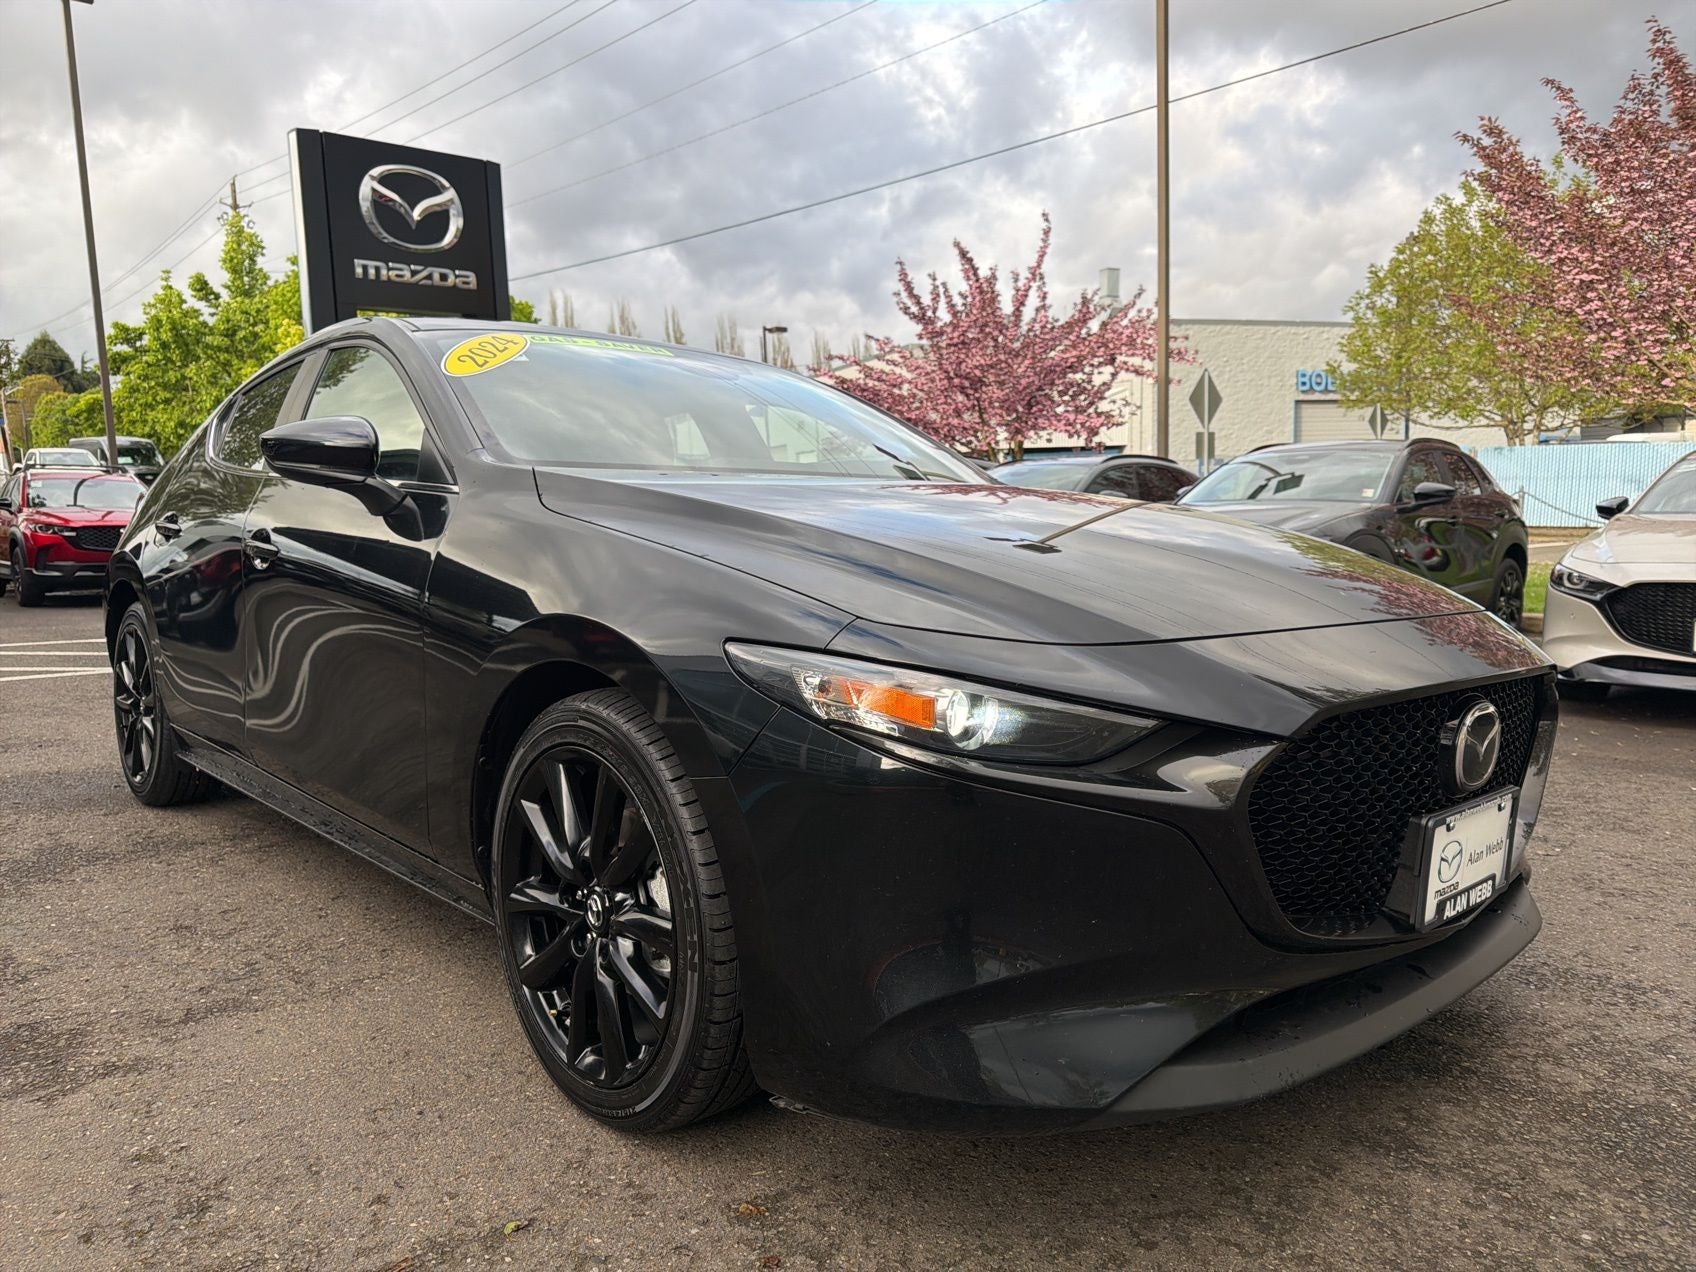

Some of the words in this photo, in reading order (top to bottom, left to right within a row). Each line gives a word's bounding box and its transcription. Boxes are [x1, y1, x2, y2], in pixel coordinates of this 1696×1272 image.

[353, 258, 478, 290] mazda
[456, 335, 520, 369] 2024
[1466, 850, 1484, 867] Alan
[1485, 837, 1504, 858] Webb
[1434, 881, 1460, 900] mazda
[1443, 891, 1468, 920] ALAN
[1469, 879, 1493, 907] WEBB
